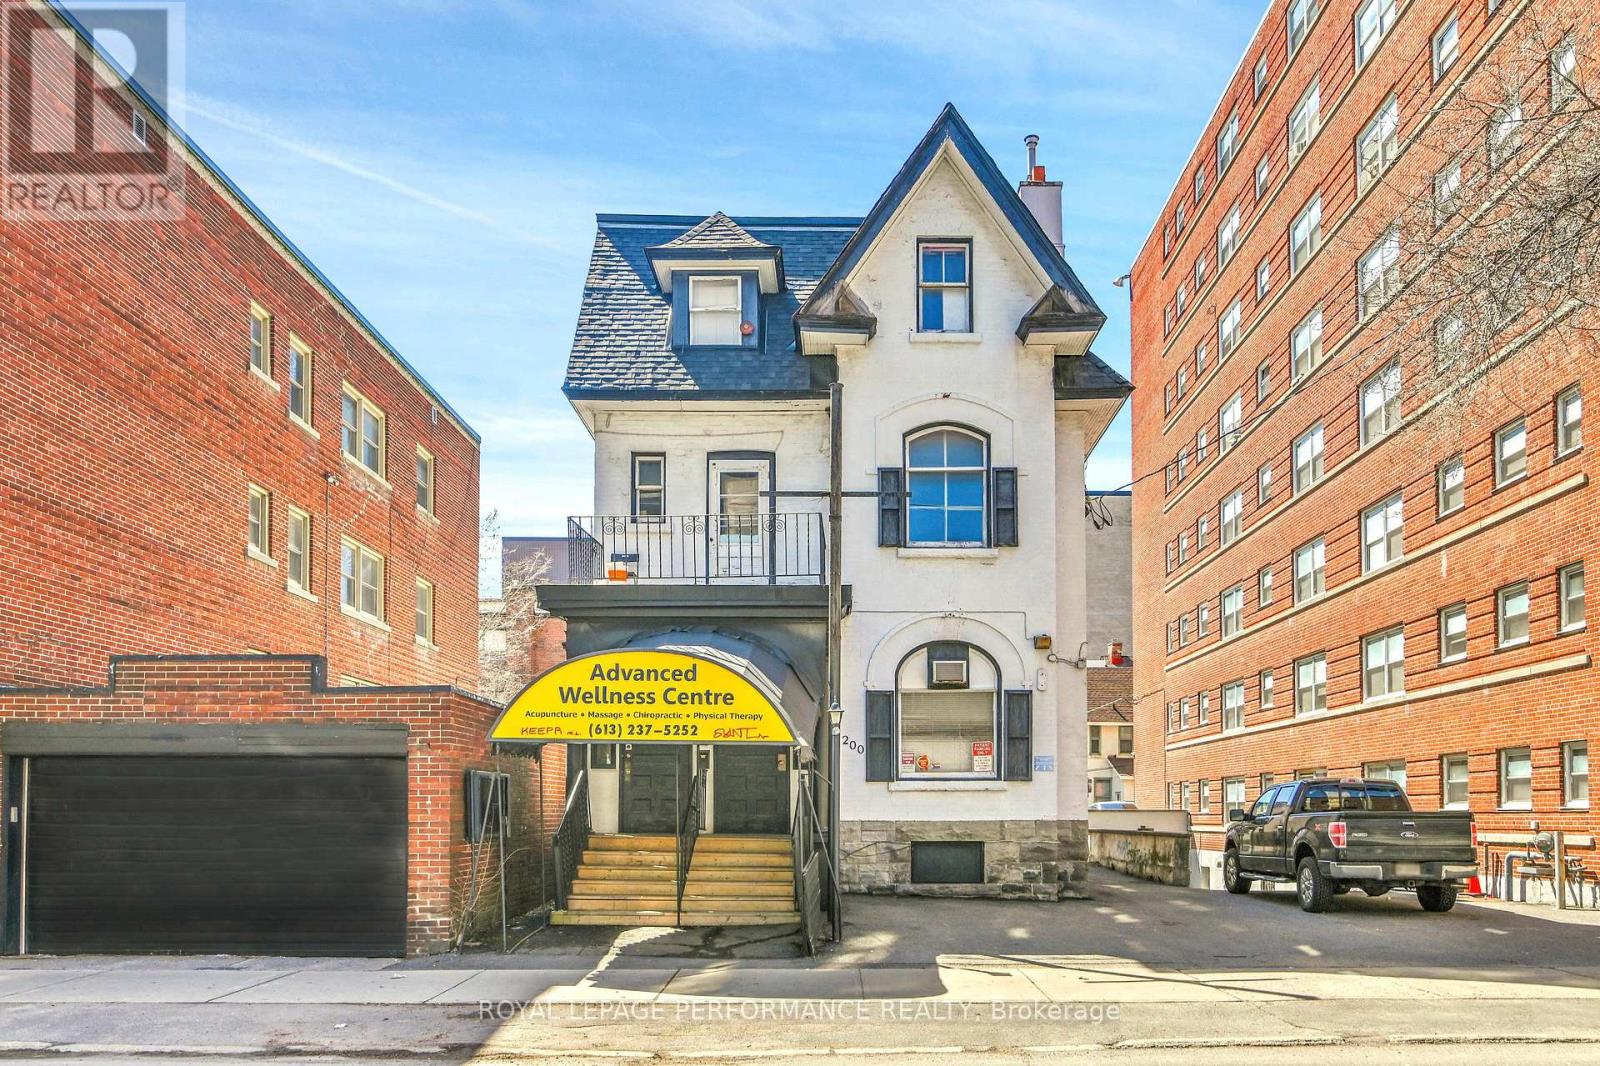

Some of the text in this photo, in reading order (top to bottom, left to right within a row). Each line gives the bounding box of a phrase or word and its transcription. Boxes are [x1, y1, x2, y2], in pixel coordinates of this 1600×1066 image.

[590, 663, 697, 682] Advanced
[559, 686, 735, 706] Wellness Centre
[525, 710, 763, 721] Acupuncture Massage Chiropractic Physical Therapy
[589, 723, 622, 738] (613)
[627, 724, 698, 736] 237-5252
[841, 735, 864, 754] 200
